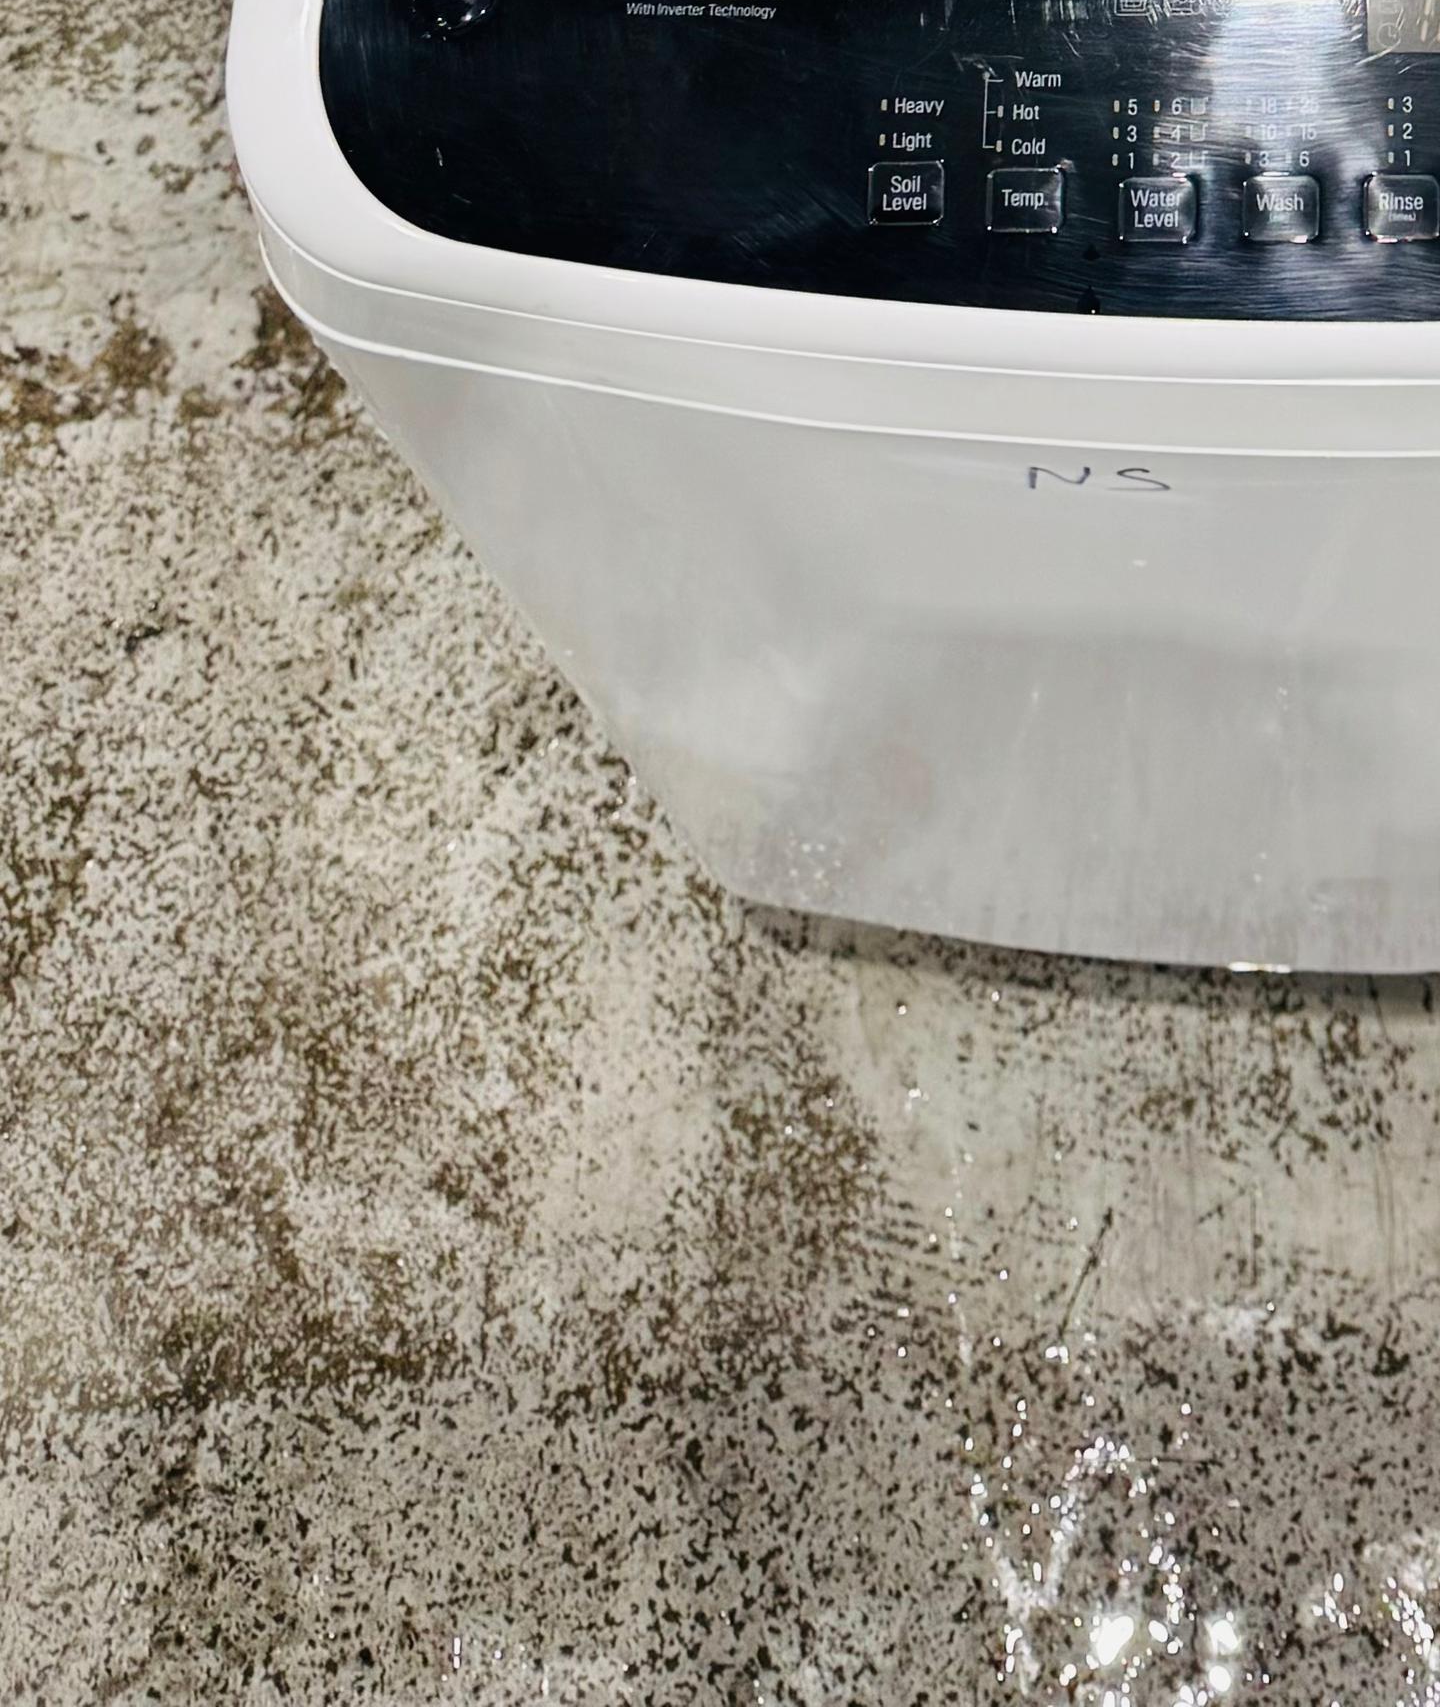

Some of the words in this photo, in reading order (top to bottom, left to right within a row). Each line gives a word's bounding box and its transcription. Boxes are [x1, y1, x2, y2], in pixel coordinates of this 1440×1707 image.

[626, 2, 656, 17] With
[657, 3, 706, 18] Inverter
[708, 4, 777, 19] Technology
[1014, 71, 1062, 88] Warm
[894, 97, 945, 119] Heavy
[1012, 103, 1040, 122] Hot
[1127, 99, 1138, 115] 5
[1171, 98, 1182, 114] 6
[1402, 95, 1413, 113] 3
[1126, 126, 1137, 142] 3
[1171, 126, 1181, 141] 4
[1402, 122, 1413, 139] 2
[891, 130, 933, 152] Light
[1010, 138, 1046, 157] Cold
[1127, 153, 1135, 169] 1
[1170, 153, 1181, 168] 2
[1258, 152, 1269, 167] 3
[1299, 151, 1310, 167] 6
[1403, 150, 1411, 167] 1
[889, 174, 922, 194] Soil
[881, 192, 928, 213] Level
[1001, 189, 1050, 211] Temp.
[1130, 189, 1183, 208] Water
[1256, 193, 1305, 212] Wash
[1379, 192, 1424, 211] Rinse
[1134, 210, 1180, 228] Level
